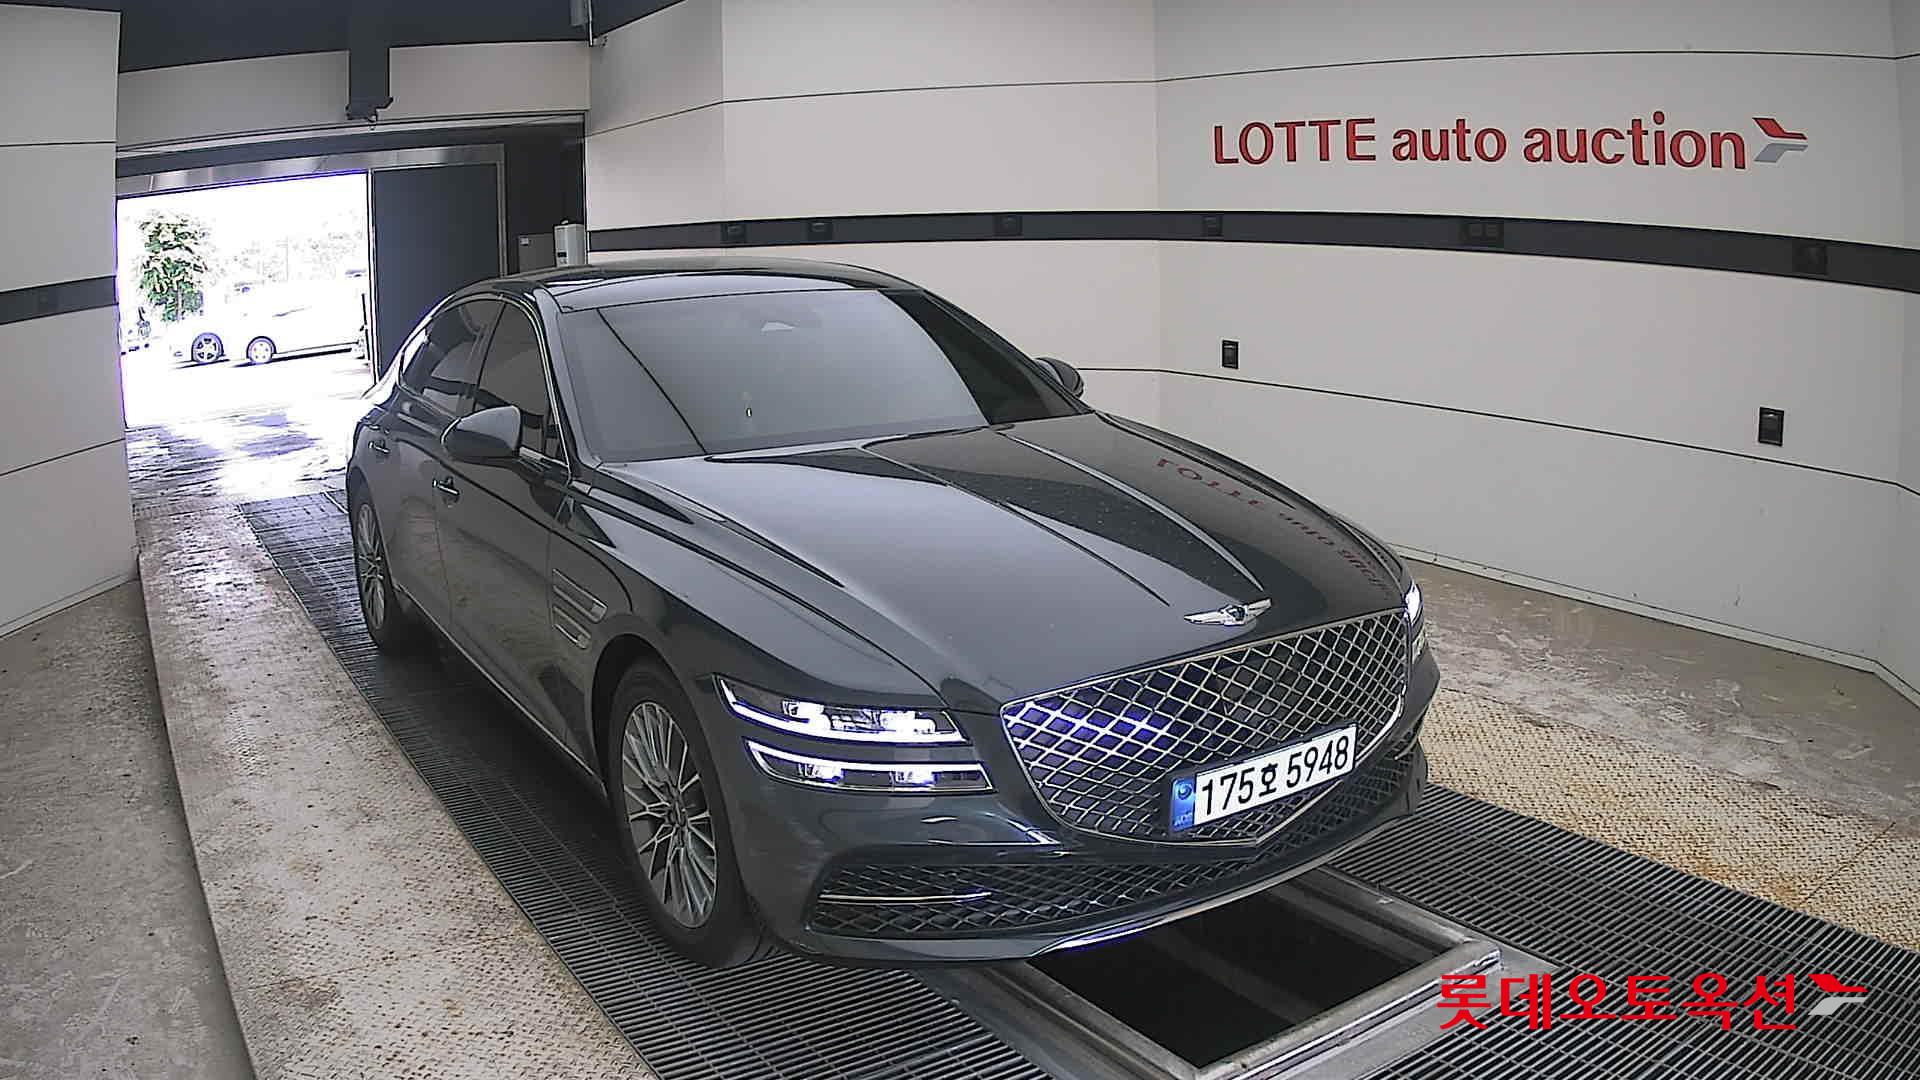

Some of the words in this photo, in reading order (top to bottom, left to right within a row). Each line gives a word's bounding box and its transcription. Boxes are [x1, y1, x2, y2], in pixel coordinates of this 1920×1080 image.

[1213, 117, 1377, 165] LOTTE
[1391, 117, 1508, 162] auto
[1522, 111, 1747, 170] auction
[1202, 763, 1279, 816] 175호
[1286, 735, 1350, 788] 5948
